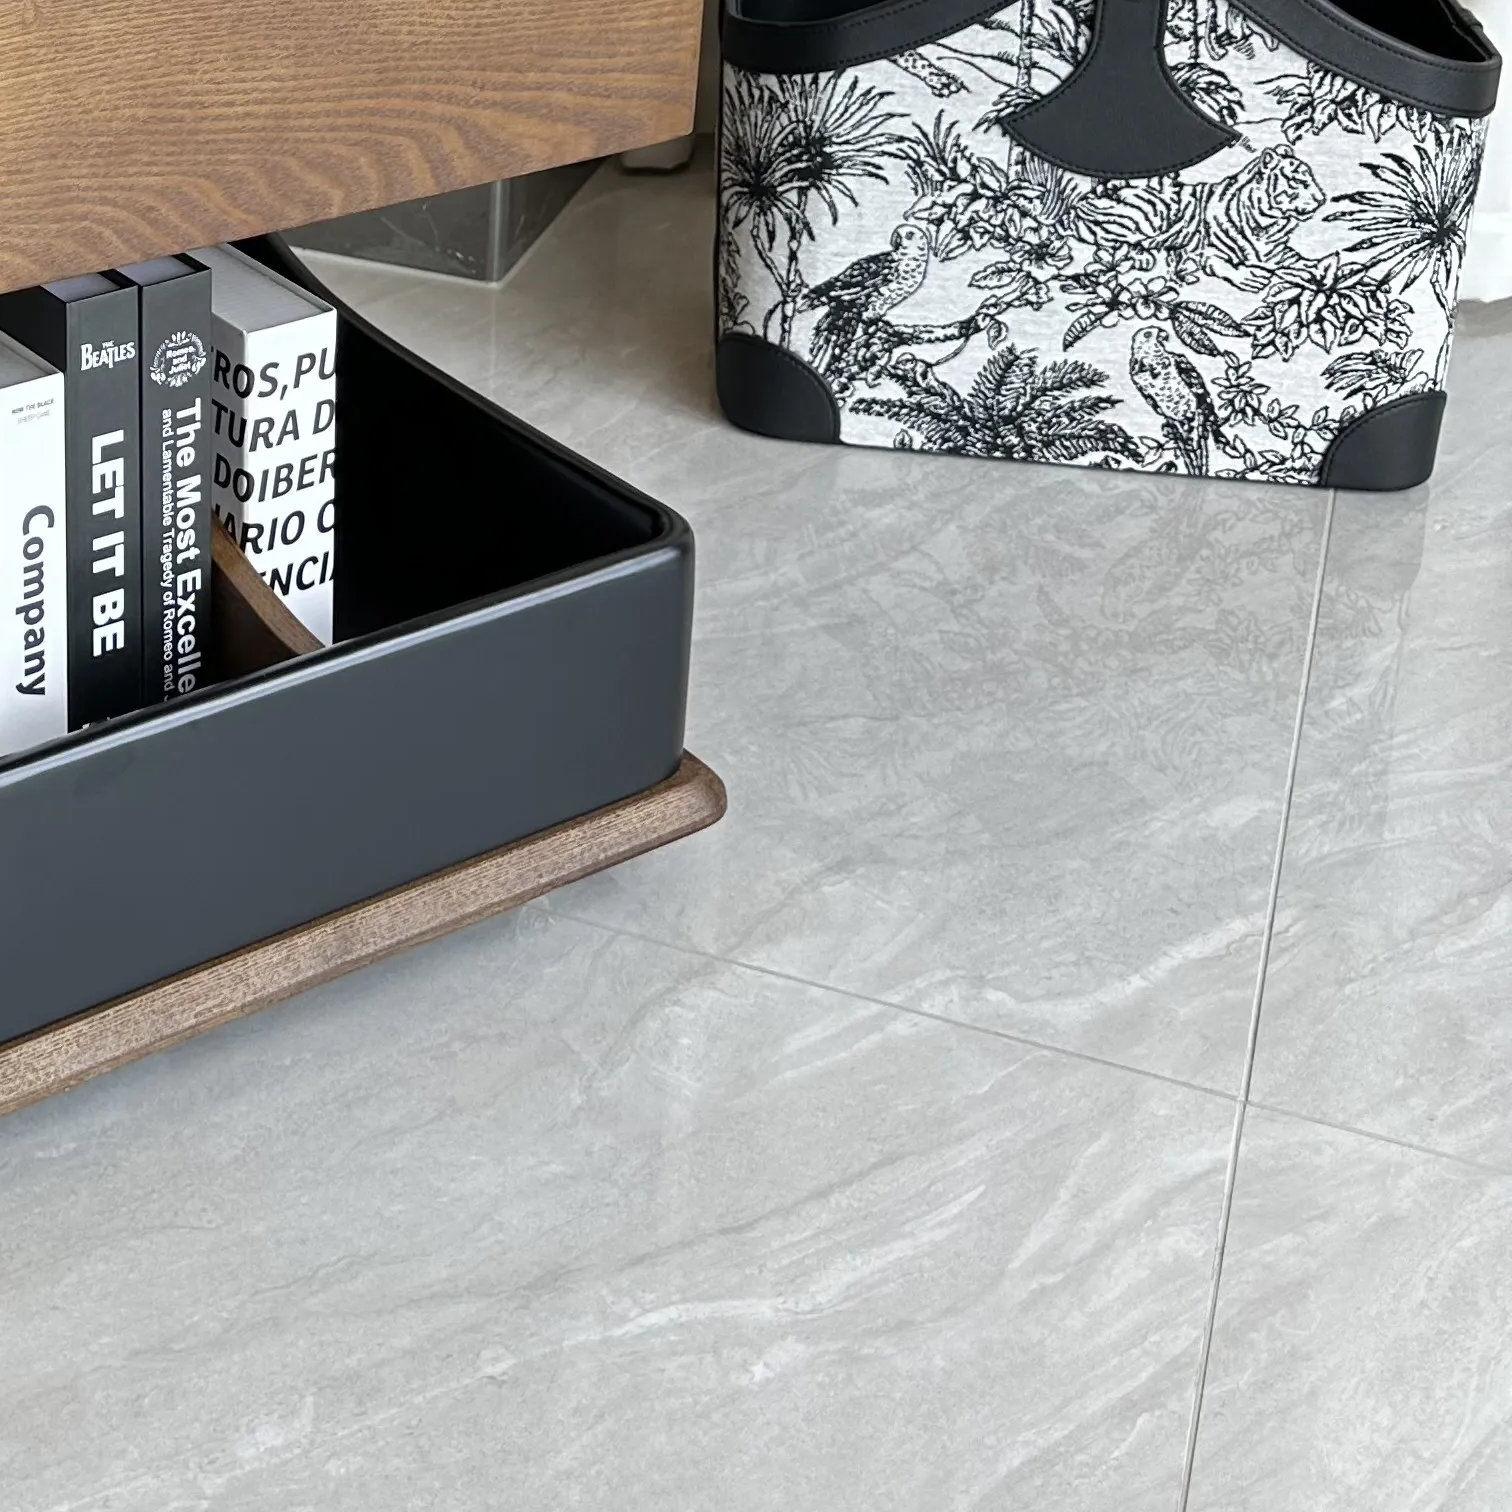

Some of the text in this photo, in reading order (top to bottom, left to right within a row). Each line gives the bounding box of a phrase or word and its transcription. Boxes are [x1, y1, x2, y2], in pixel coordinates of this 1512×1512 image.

[80, 342, 136, 371] BEATLES
[162, 408, 175, 438] and
[176, 397, 202, 468] The
[211, 398, 300, 453] TURA
[162, 439, 175, 527] Lamentable
[92, 429, 125, 657] LET IT BE
[176, 474, 202, 565] Most
[160, 528, 175, 588] Tragedy
[15, 504, 55, 696] Company
[162, 591, 175, 606] of
[163, 608, 175, 661] Romeo
[163, 664, 175, 692] and
